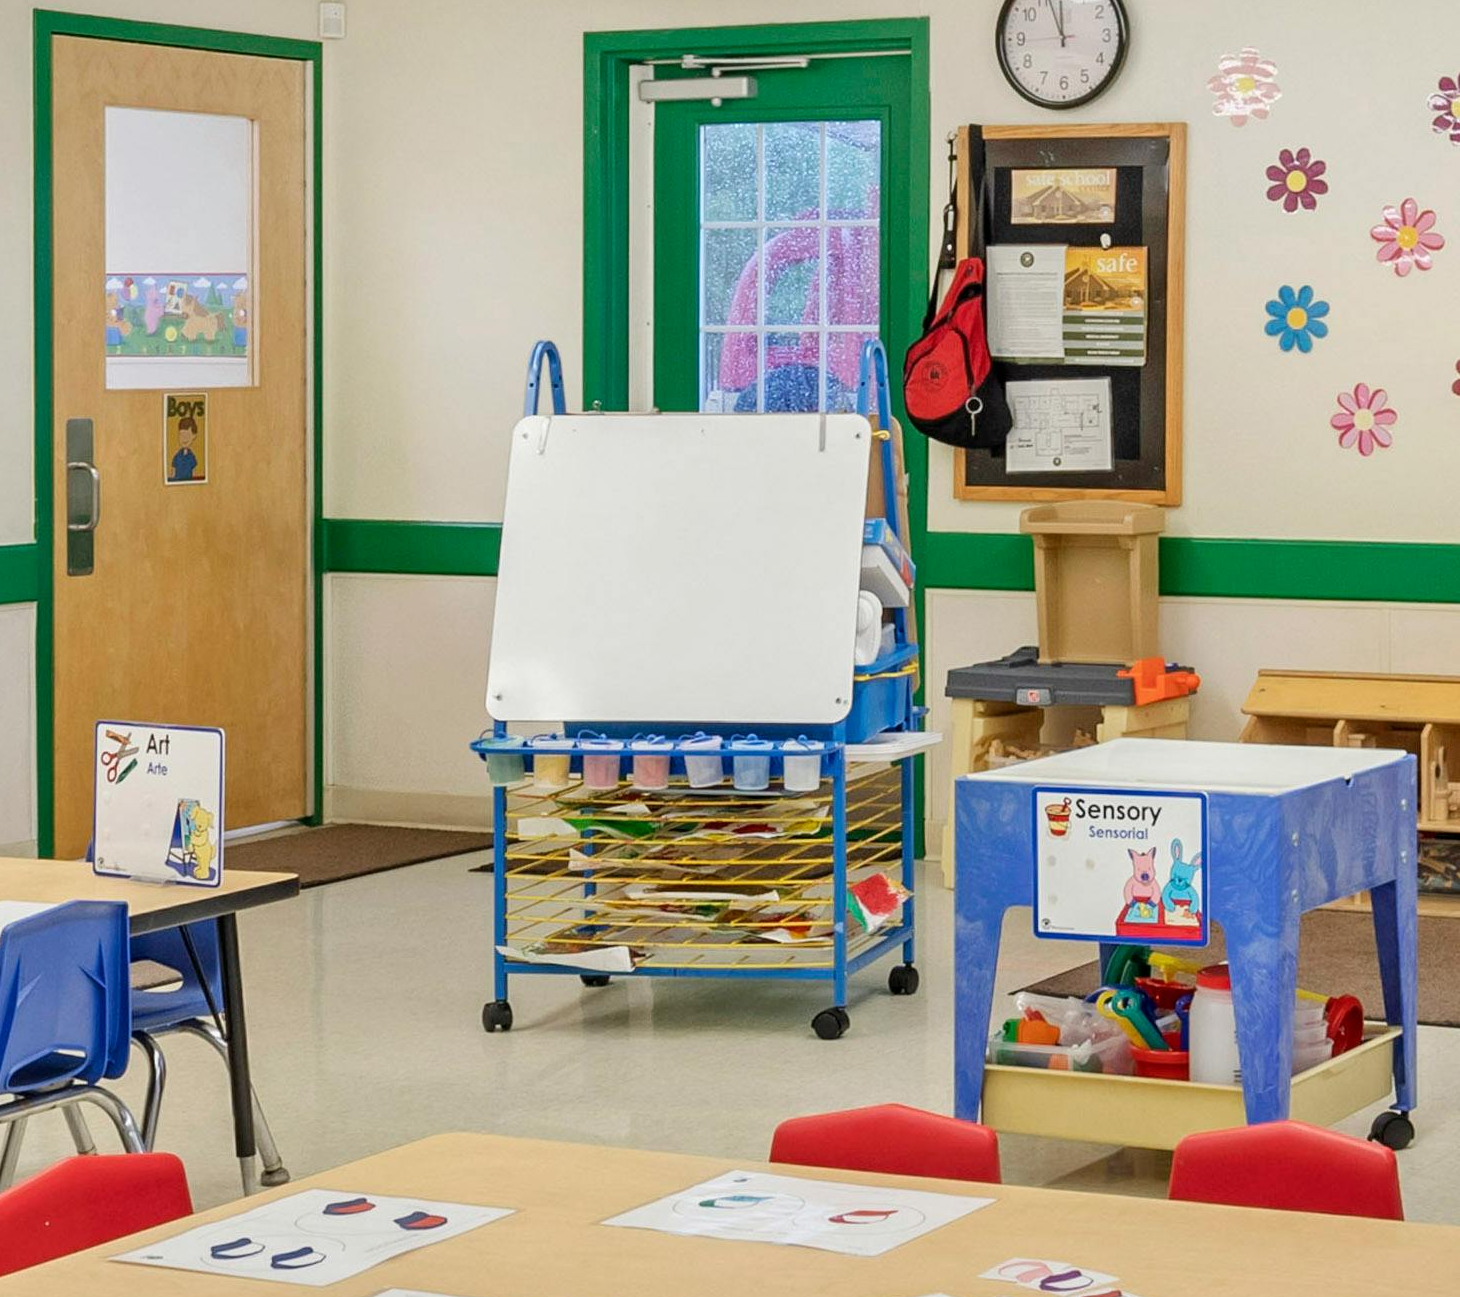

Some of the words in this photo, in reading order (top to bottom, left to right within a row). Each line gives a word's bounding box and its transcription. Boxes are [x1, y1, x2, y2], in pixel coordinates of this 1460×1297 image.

[1023, 7, 1037, 22] 10
[1095, 5, 1104, 20] 2
[1016, 32, 1026, 47] 9
[1102, 28, 1111, 43] 3
[1023, 54, 1032, 69] 8
[1095, 52, 1104, 65] 4
[1040, 71, 1049, 85] 7
[1059, 76, 1069, 91] 6
[1080, 69, 1090, 84] 5
[1026, 171, 1053, 186] safe
[1059, 170, 1110, 186] school
[1096, 253, 1138, 273] safe
[167, 396, 205, 419] Boys
[146, 733, 170, 755] Art
[147, 762, 168, 776] Arte
[1075, 798, 1162, 826] Sensory
[1088, 825, 1149, 840] Sensorial
